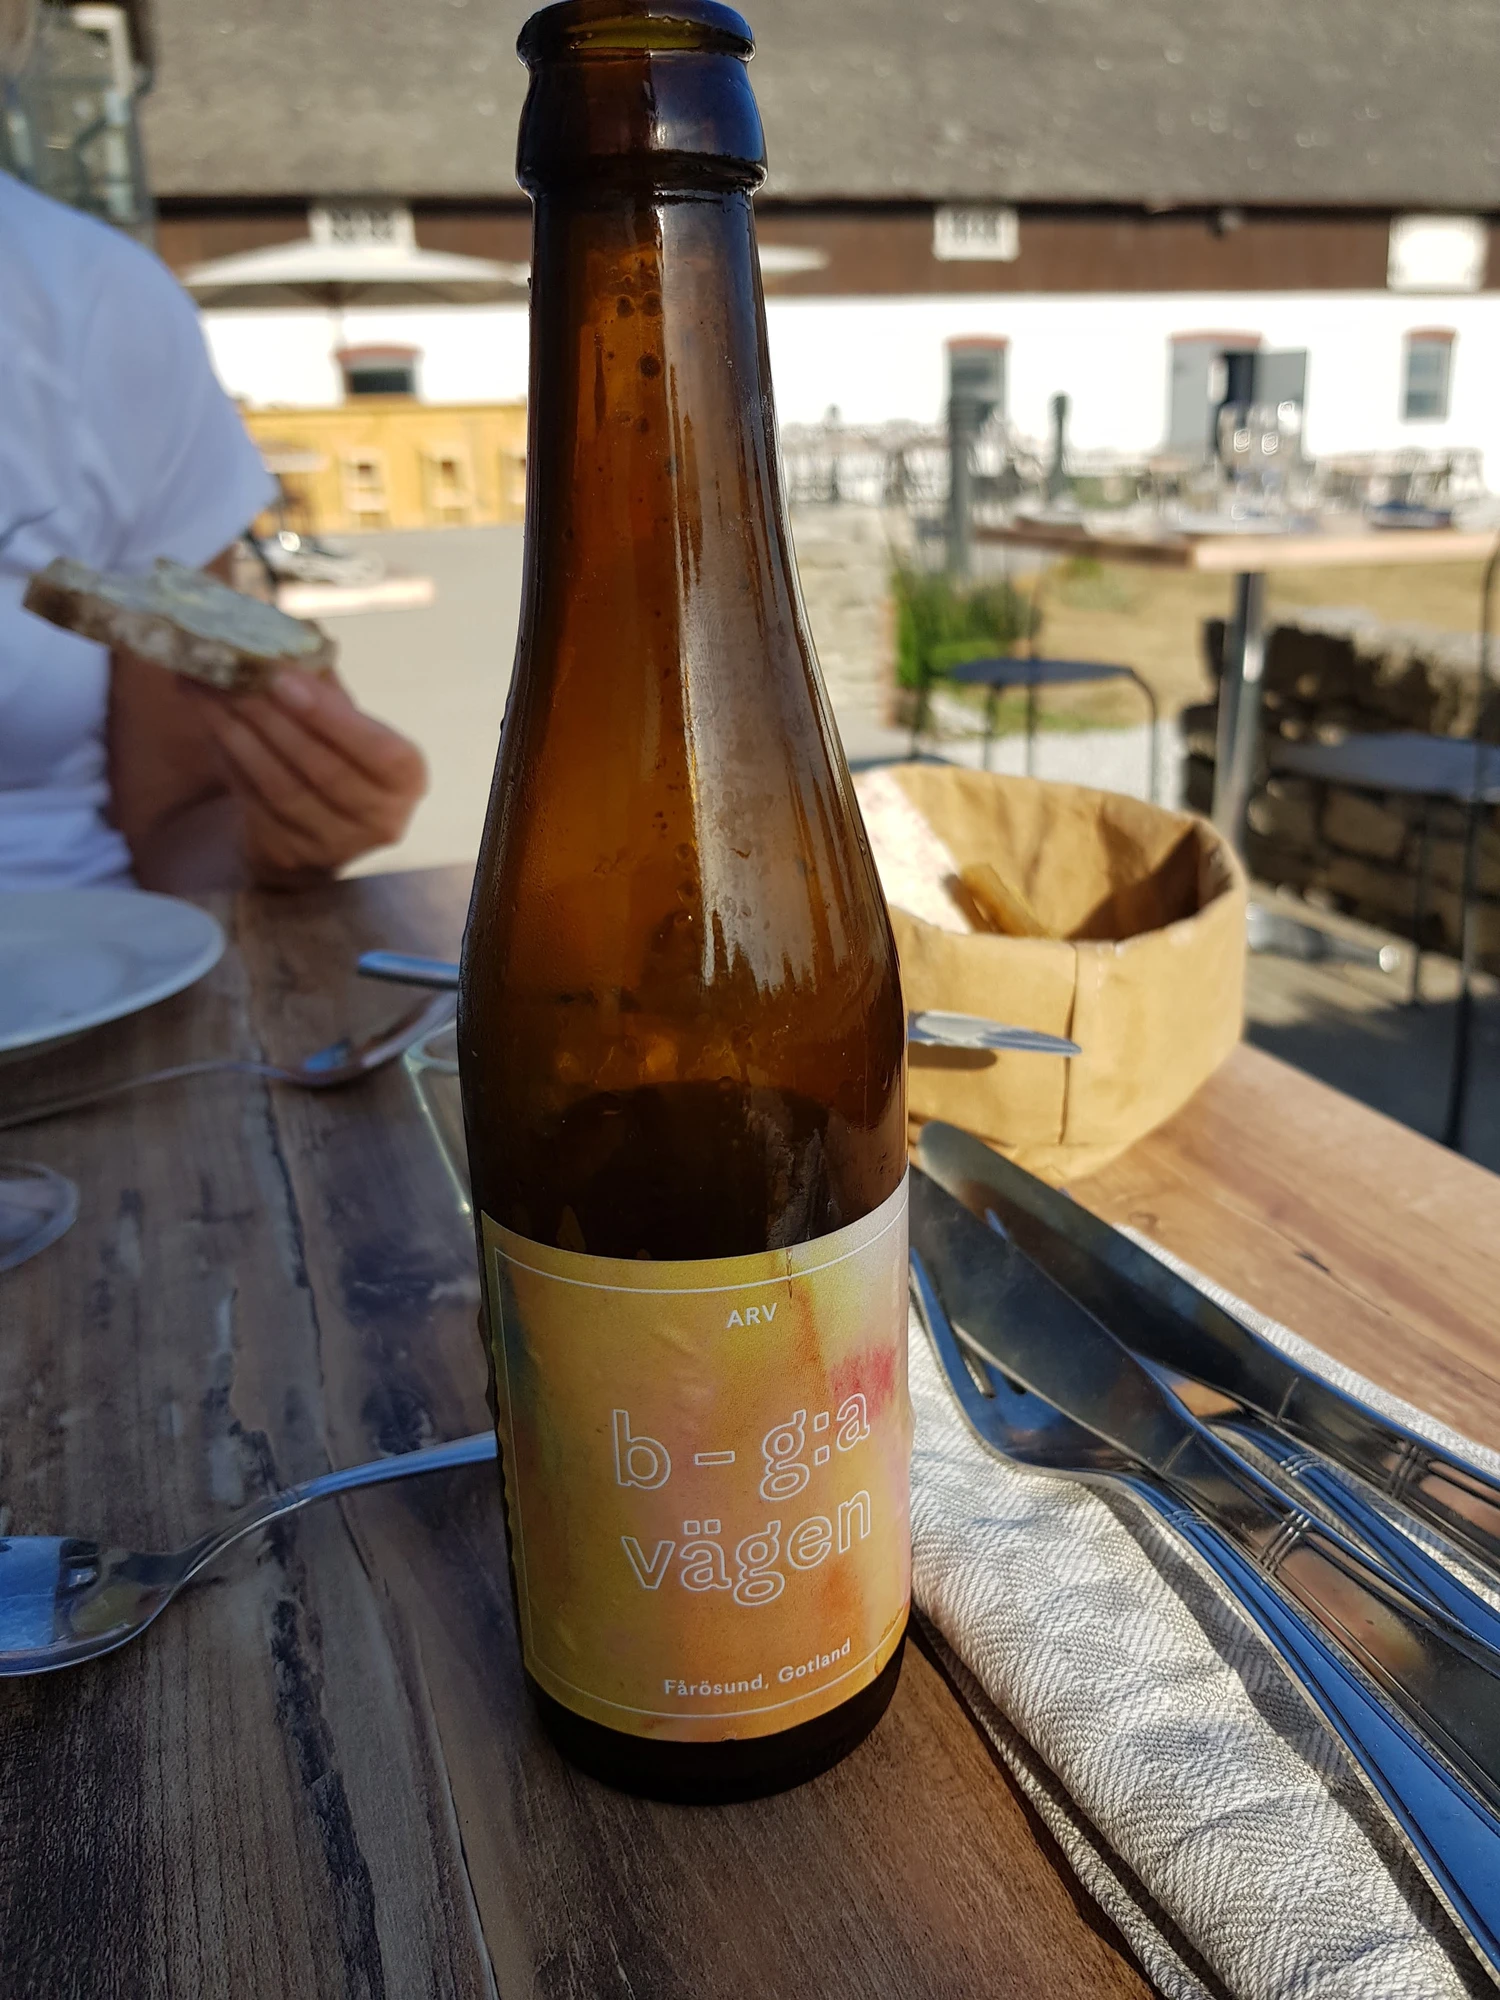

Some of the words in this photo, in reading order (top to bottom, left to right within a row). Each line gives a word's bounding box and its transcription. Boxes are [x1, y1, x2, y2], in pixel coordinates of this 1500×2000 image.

[725, 1301, 779, 1329] ARV
[611, 1408, 672, 1490] b
[759, 1392, 871, 1502] g:a
[621, 1489, 872, 1607] vägen
[663, 1673, 769, 1697] Fårösund,
[778, 1637, 852, 1684] Gotland
